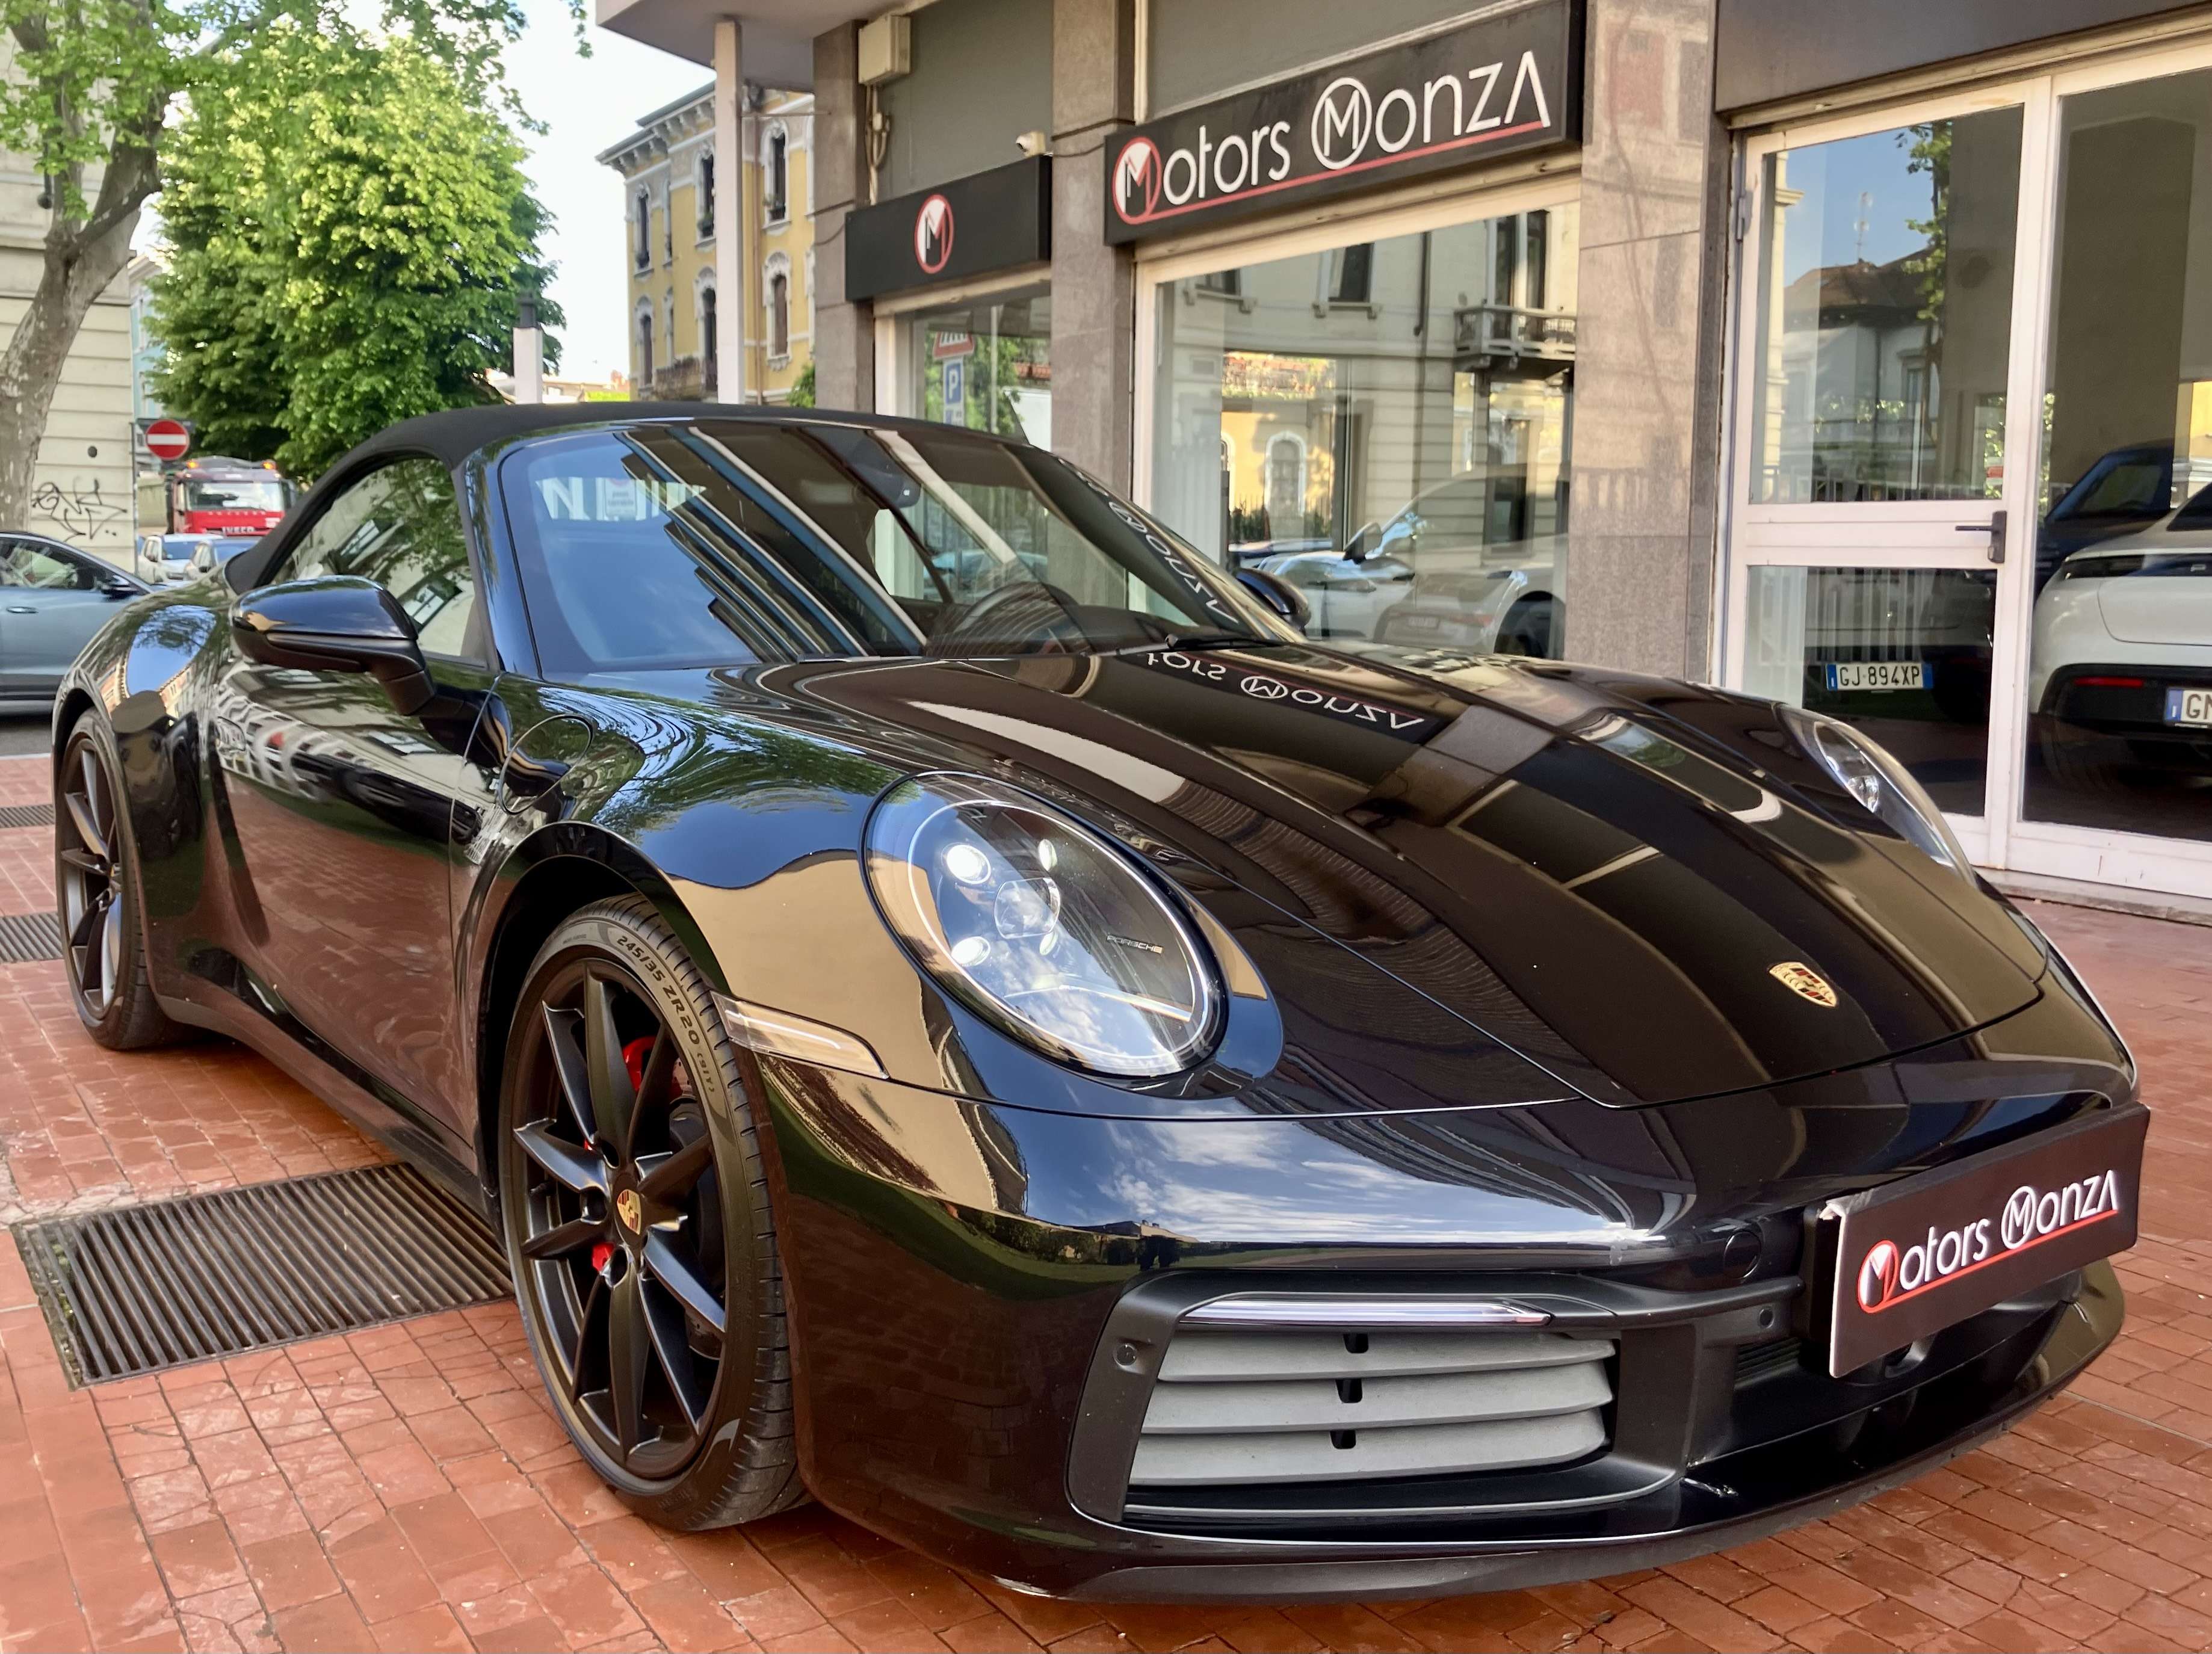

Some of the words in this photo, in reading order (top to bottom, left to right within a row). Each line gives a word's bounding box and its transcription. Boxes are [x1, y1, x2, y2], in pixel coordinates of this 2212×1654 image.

[1112, 120, 1291, 225] Motors
[948, 368, 959, 400] P
[616, 936, 666, 982] 245/35
[663, 984, 700, 1045] ZR20
[1107, 934, 1163, 954] PORSCHE
[1857, 1217, 1991, 1314] Motors
